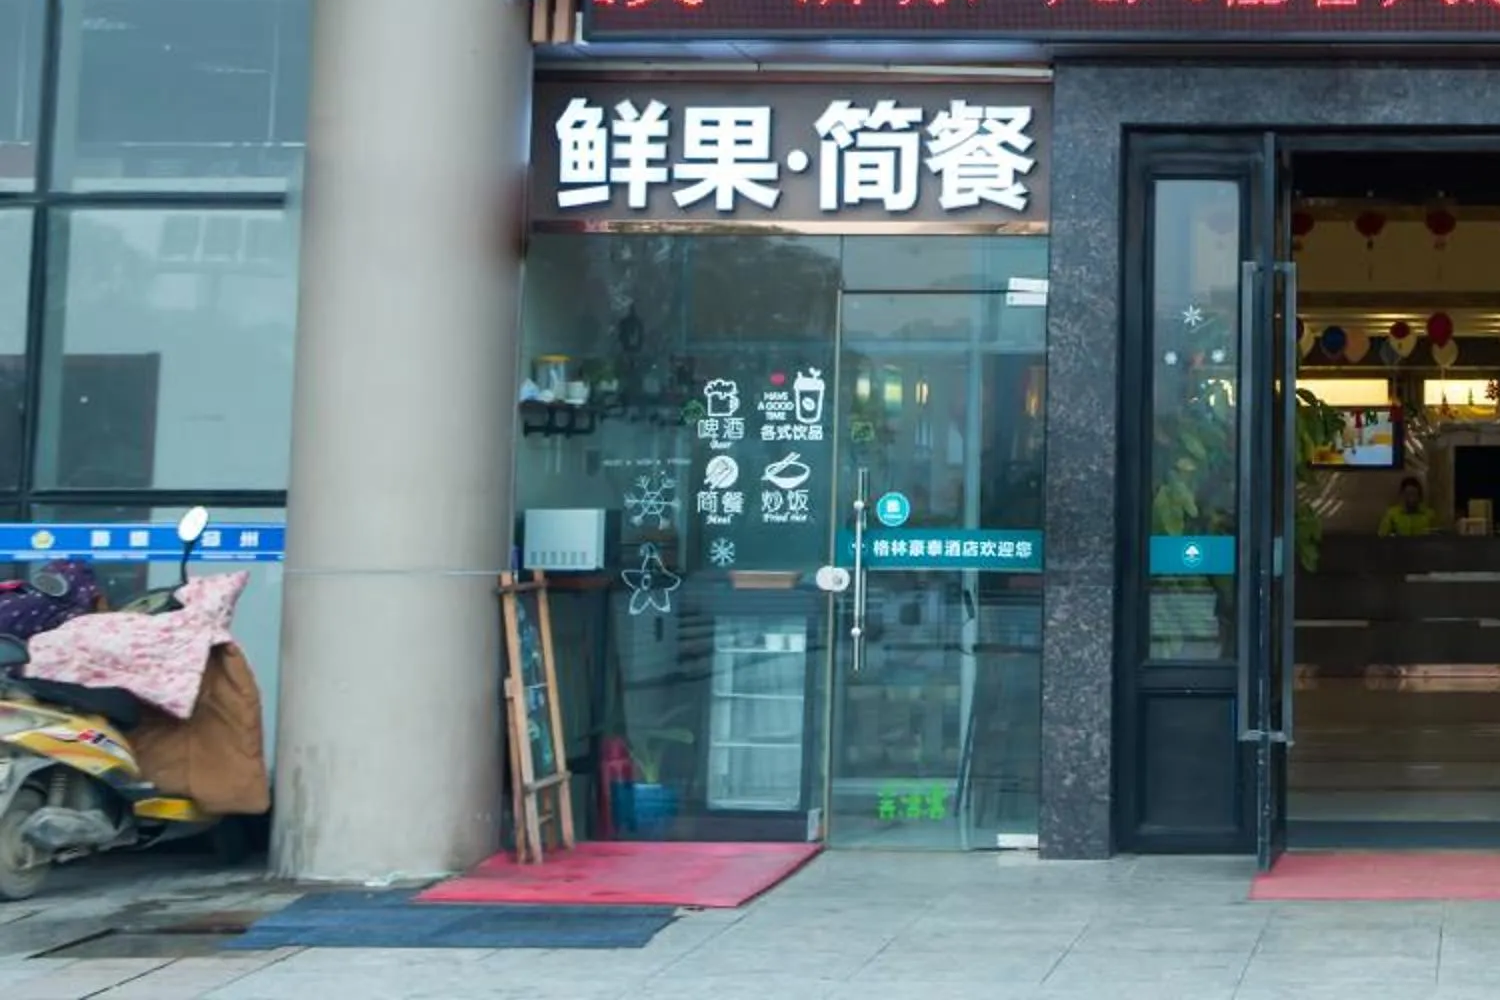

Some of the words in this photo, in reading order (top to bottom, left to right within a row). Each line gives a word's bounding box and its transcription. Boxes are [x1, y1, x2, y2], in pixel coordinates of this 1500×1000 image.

[555, 97, 1034, 211] 鲜果·简餐
[697, 417, 745, 439] 啤酒
[761, 489, 810, 512] 炒饭
[872, 538, 1033, 558] 格林豪泰酒店欢迎您
